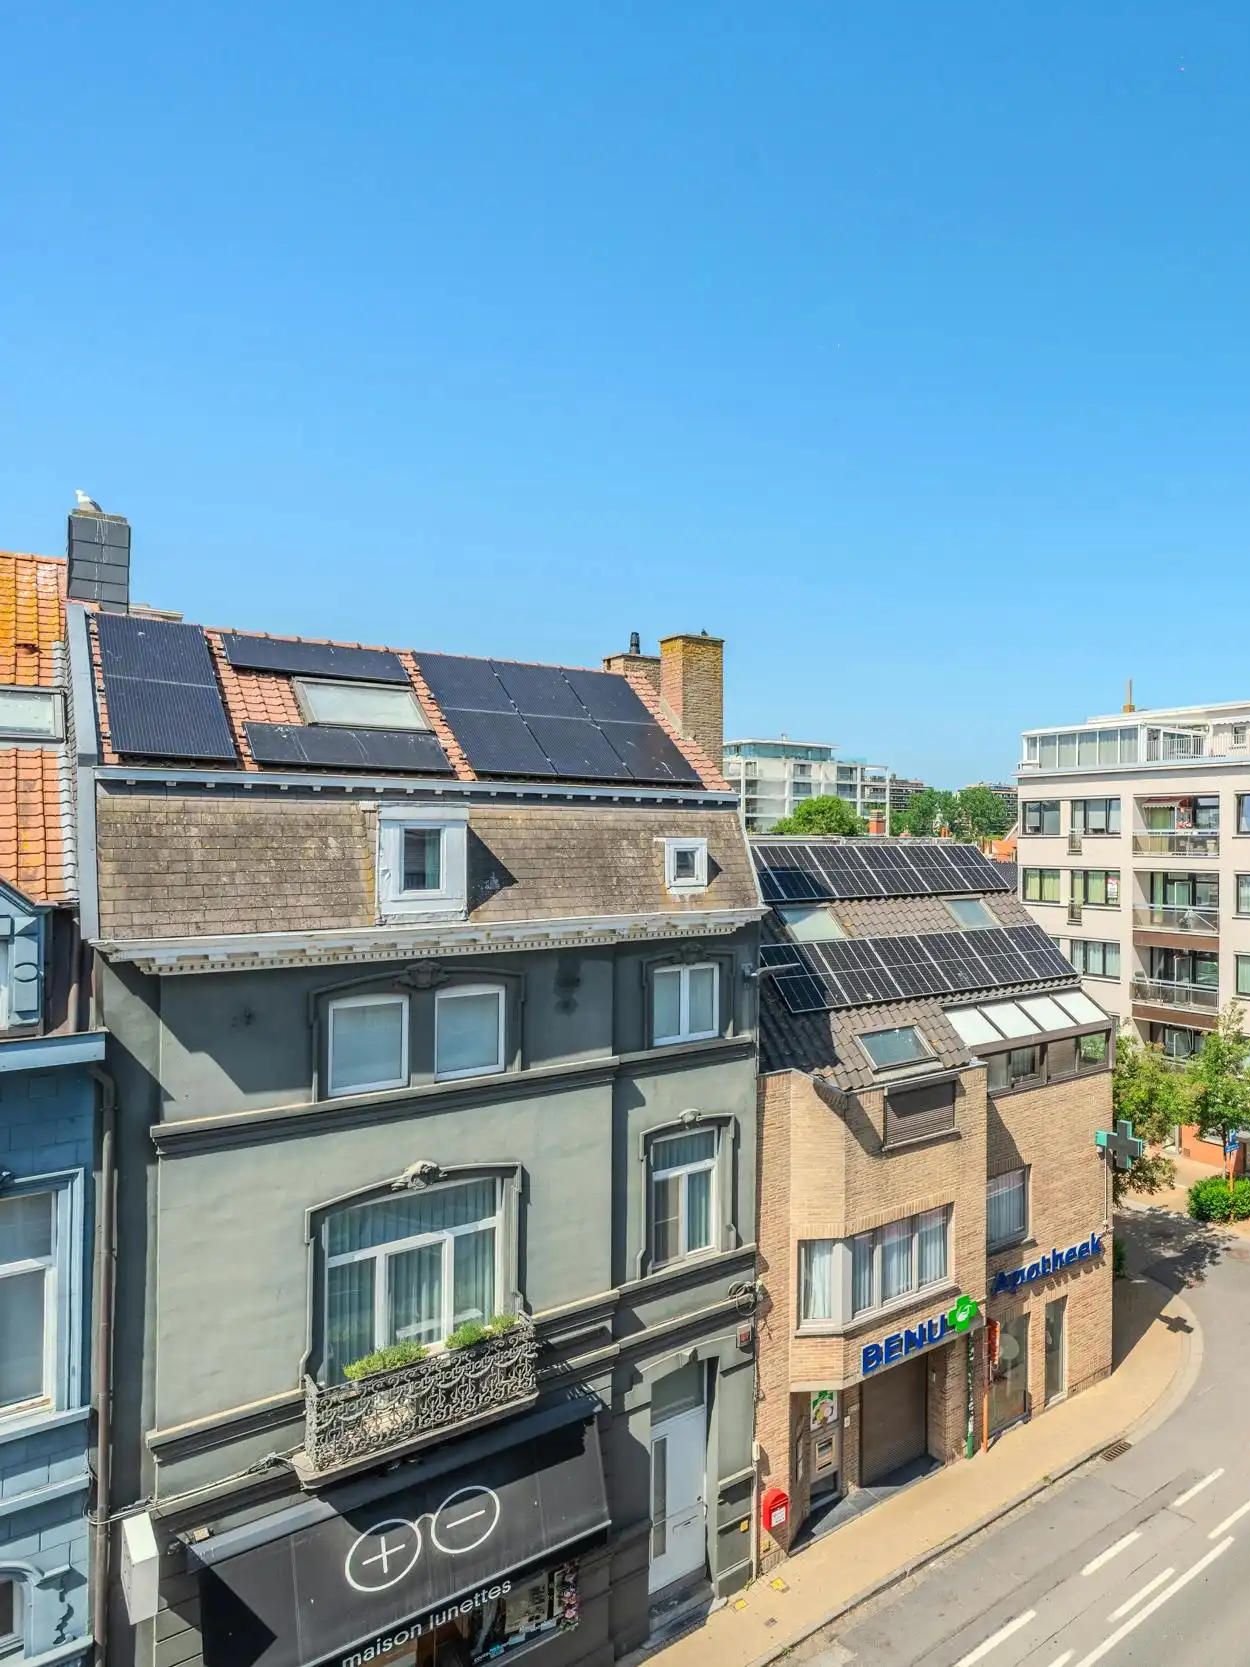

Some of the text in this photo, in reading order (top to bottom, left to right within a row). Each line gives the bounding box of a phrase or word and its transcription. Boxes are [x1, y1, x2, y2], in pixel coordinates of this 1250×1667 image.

[990, 1231, 1104, 1295] Apotheek
[861, 1312, 946, 1377] BENU
[341, 1623, 422, 1667] maison
[429, 1579, 512, 1630] lunettes
